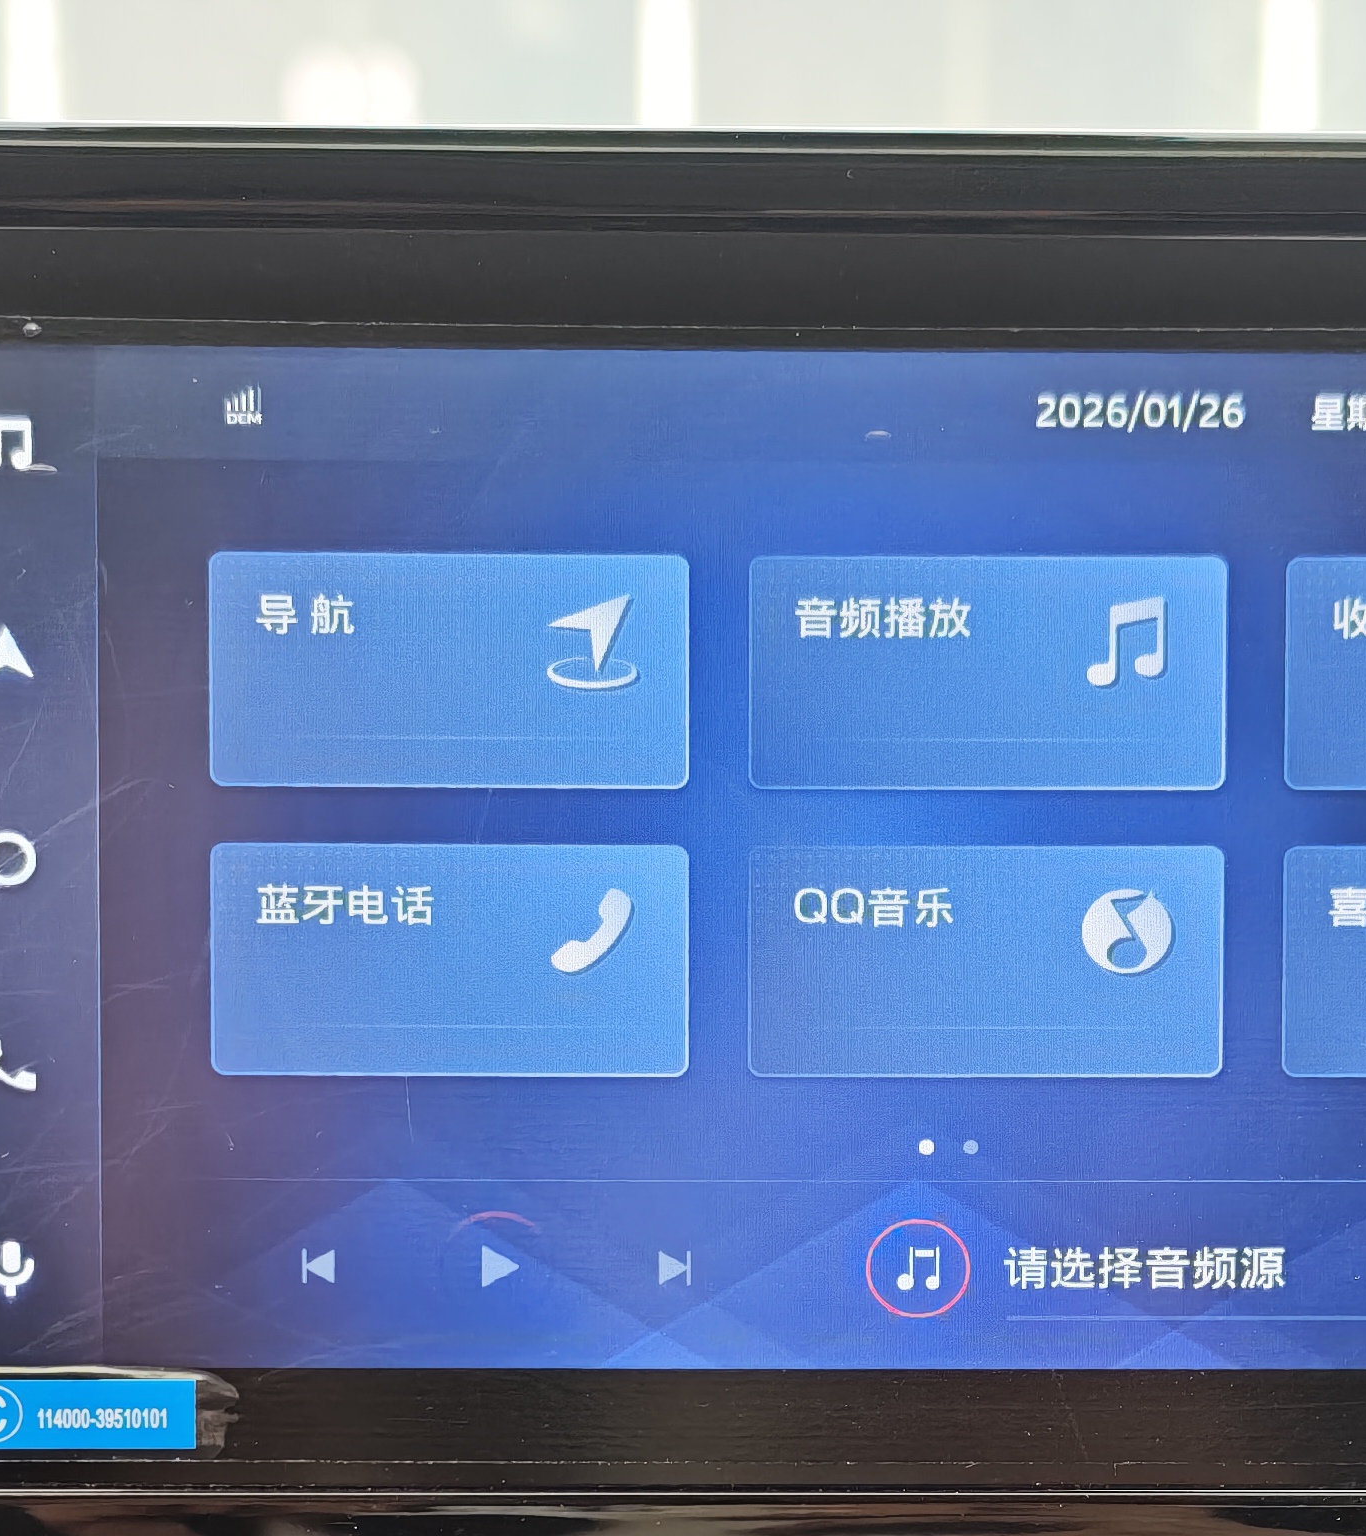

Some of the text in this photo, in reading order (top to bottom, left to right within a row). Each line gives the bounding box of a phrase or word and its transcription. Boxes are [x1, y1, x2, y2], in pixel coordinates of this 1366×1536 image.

[1035, 392, 1246, 433] 2026/01/26
[255, 594, 354, 635] 导航
[794, 597, 972, 640] 音频播放
[256, 884, 434, 926] 蓝牙电话
[793, 886, 954, 928] QQ音乐
[1003, 1245, 1287, 1292] 请选择音频源
[37, 1407, 168, 1429] 114000-39510101
